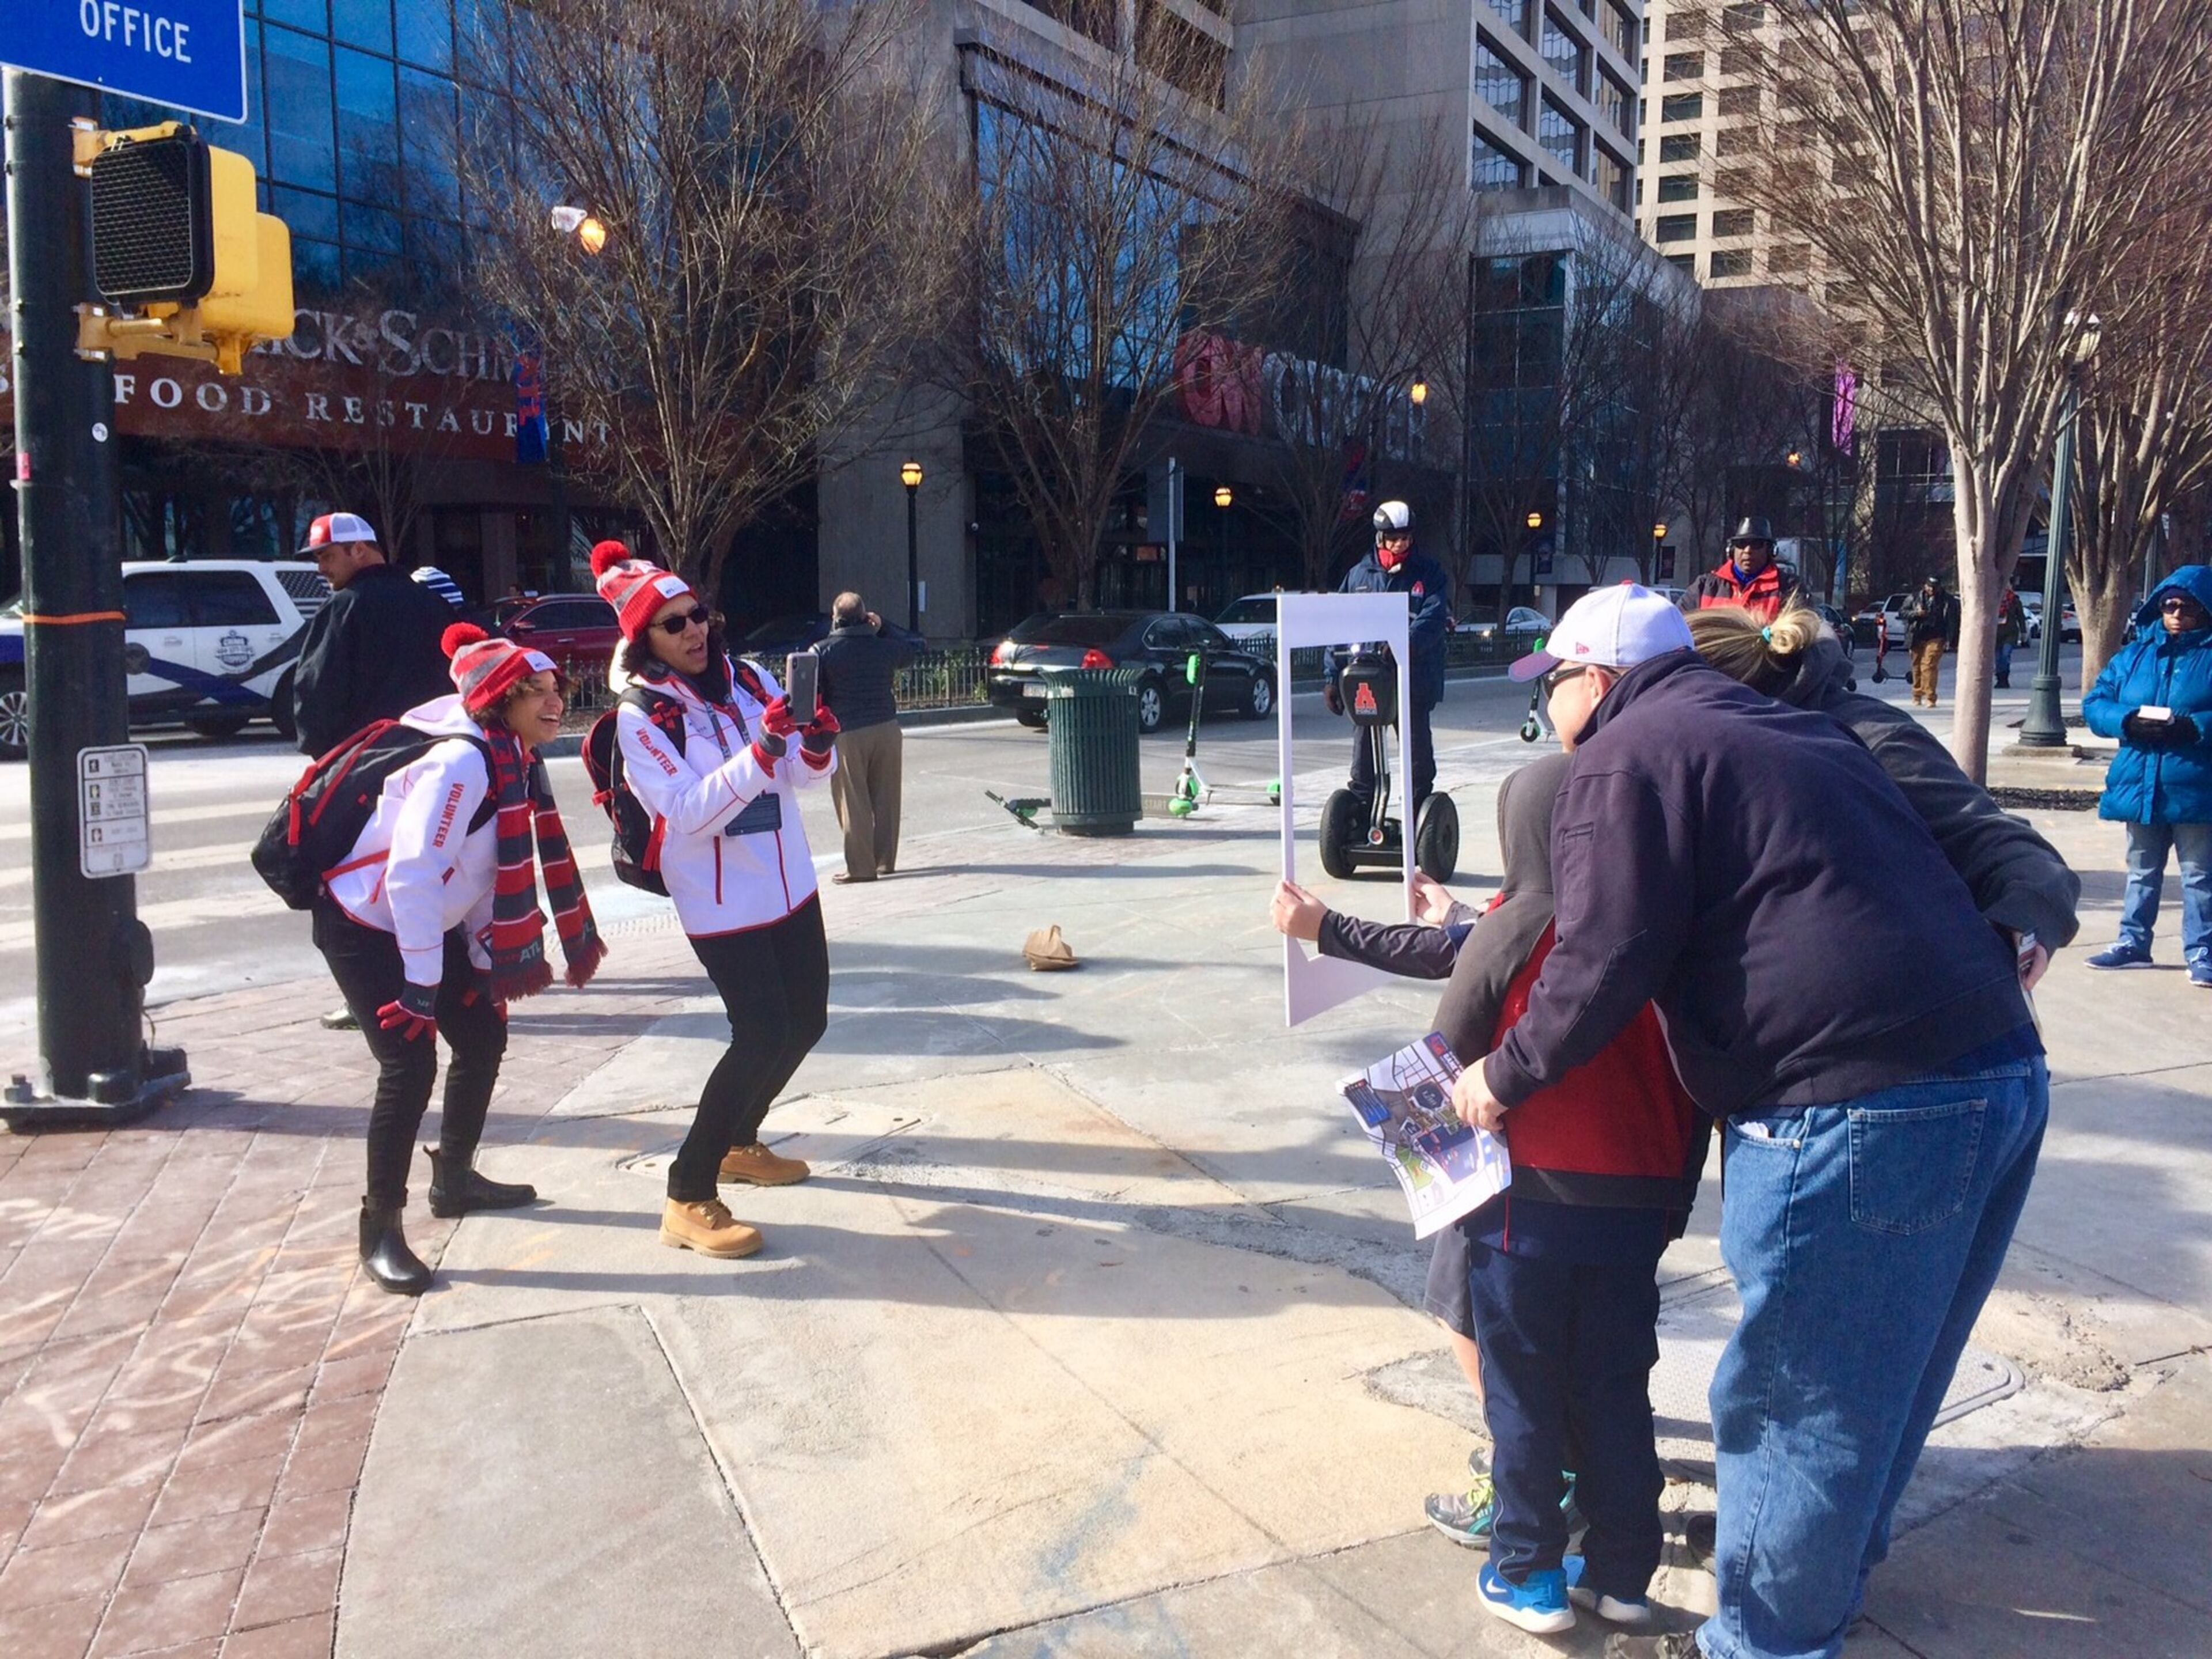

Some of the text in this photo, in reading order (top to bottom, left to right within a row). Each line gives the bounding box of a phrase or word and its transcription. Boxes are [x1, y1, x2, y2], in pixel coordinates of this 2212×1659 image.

[80, 0, 192, 63] OFFICE
[305, 392, 611, 447] RESTAURNT
[433, 783, 464, 847] VOLUNTEER
[519, 941, 541, 963] ATL
